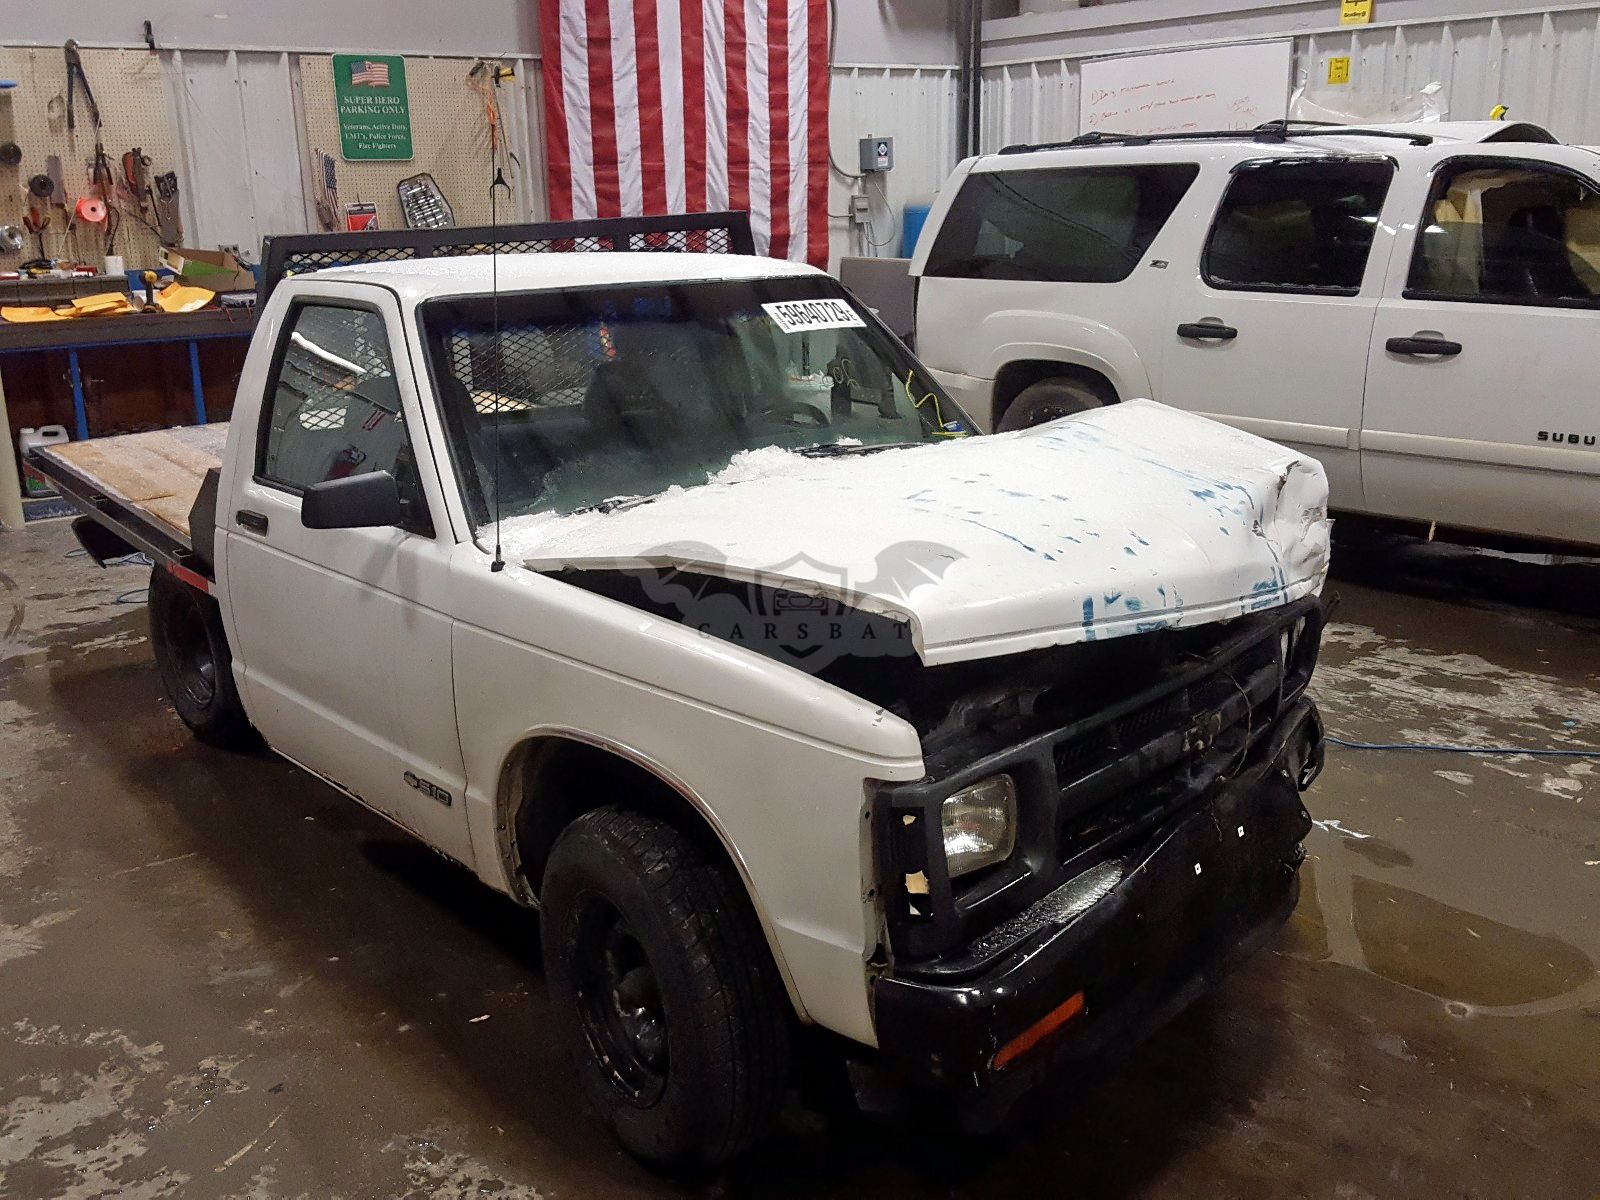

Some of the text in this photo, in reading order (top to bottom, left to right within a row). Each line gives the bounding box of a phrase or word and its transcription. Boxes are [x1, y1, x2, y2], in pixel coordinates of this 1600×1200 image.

[344, 96, 400, 105] SUPER HERO
[341, 106, 405, 114] PARKING ONLY
[372, 123, 391, 131] Active
[369, 132, 387, 141] Police
[775, 302, 850, 325] 59640729
[1537, 431, 1596, 445] SUBU
